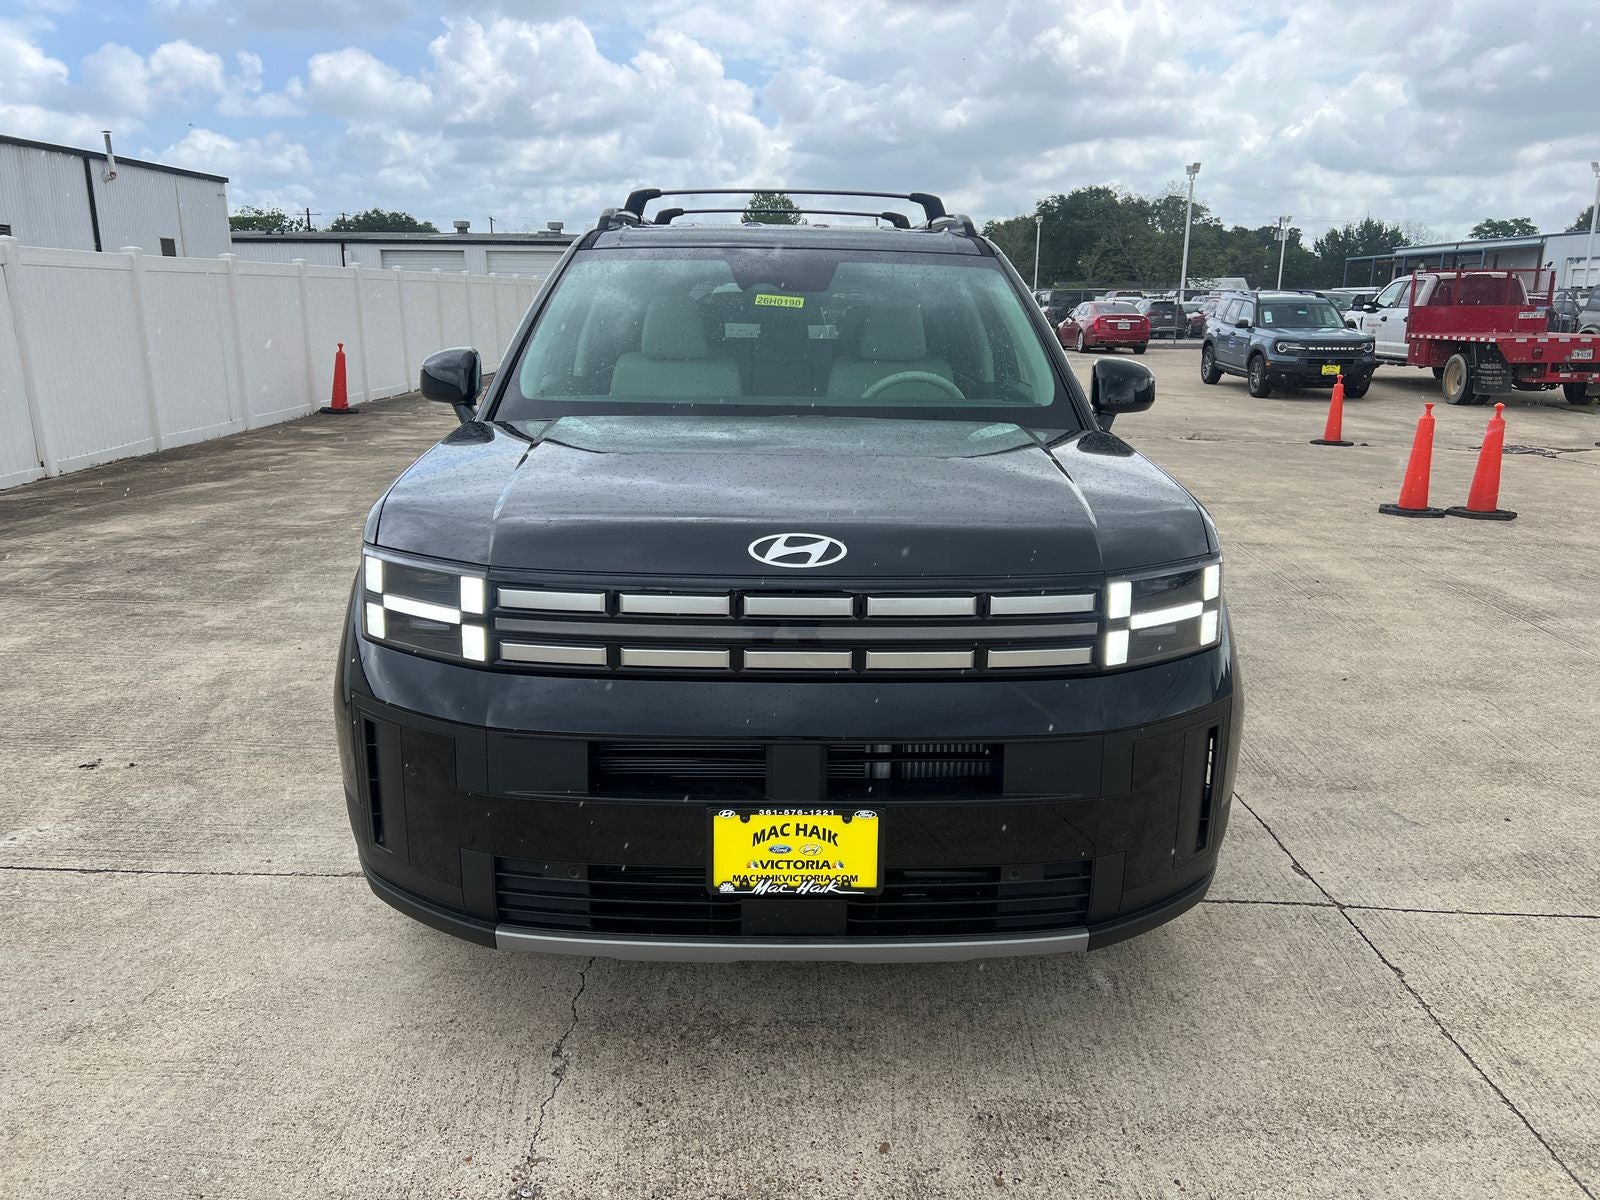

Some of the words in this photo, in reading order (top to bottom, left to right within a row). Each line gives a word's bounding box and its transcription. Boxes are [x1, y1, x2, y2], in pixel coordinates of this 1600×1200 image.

[757, 296, 801, 306] 26H0190
[752, 822, 791, 847] MAC
[795, 822, 839, 847] HAIK
[759, 859, 832, 870] VICTORIA
[752, 879, 794, 895] Mac
[795, 878, 840, 895] Haik
